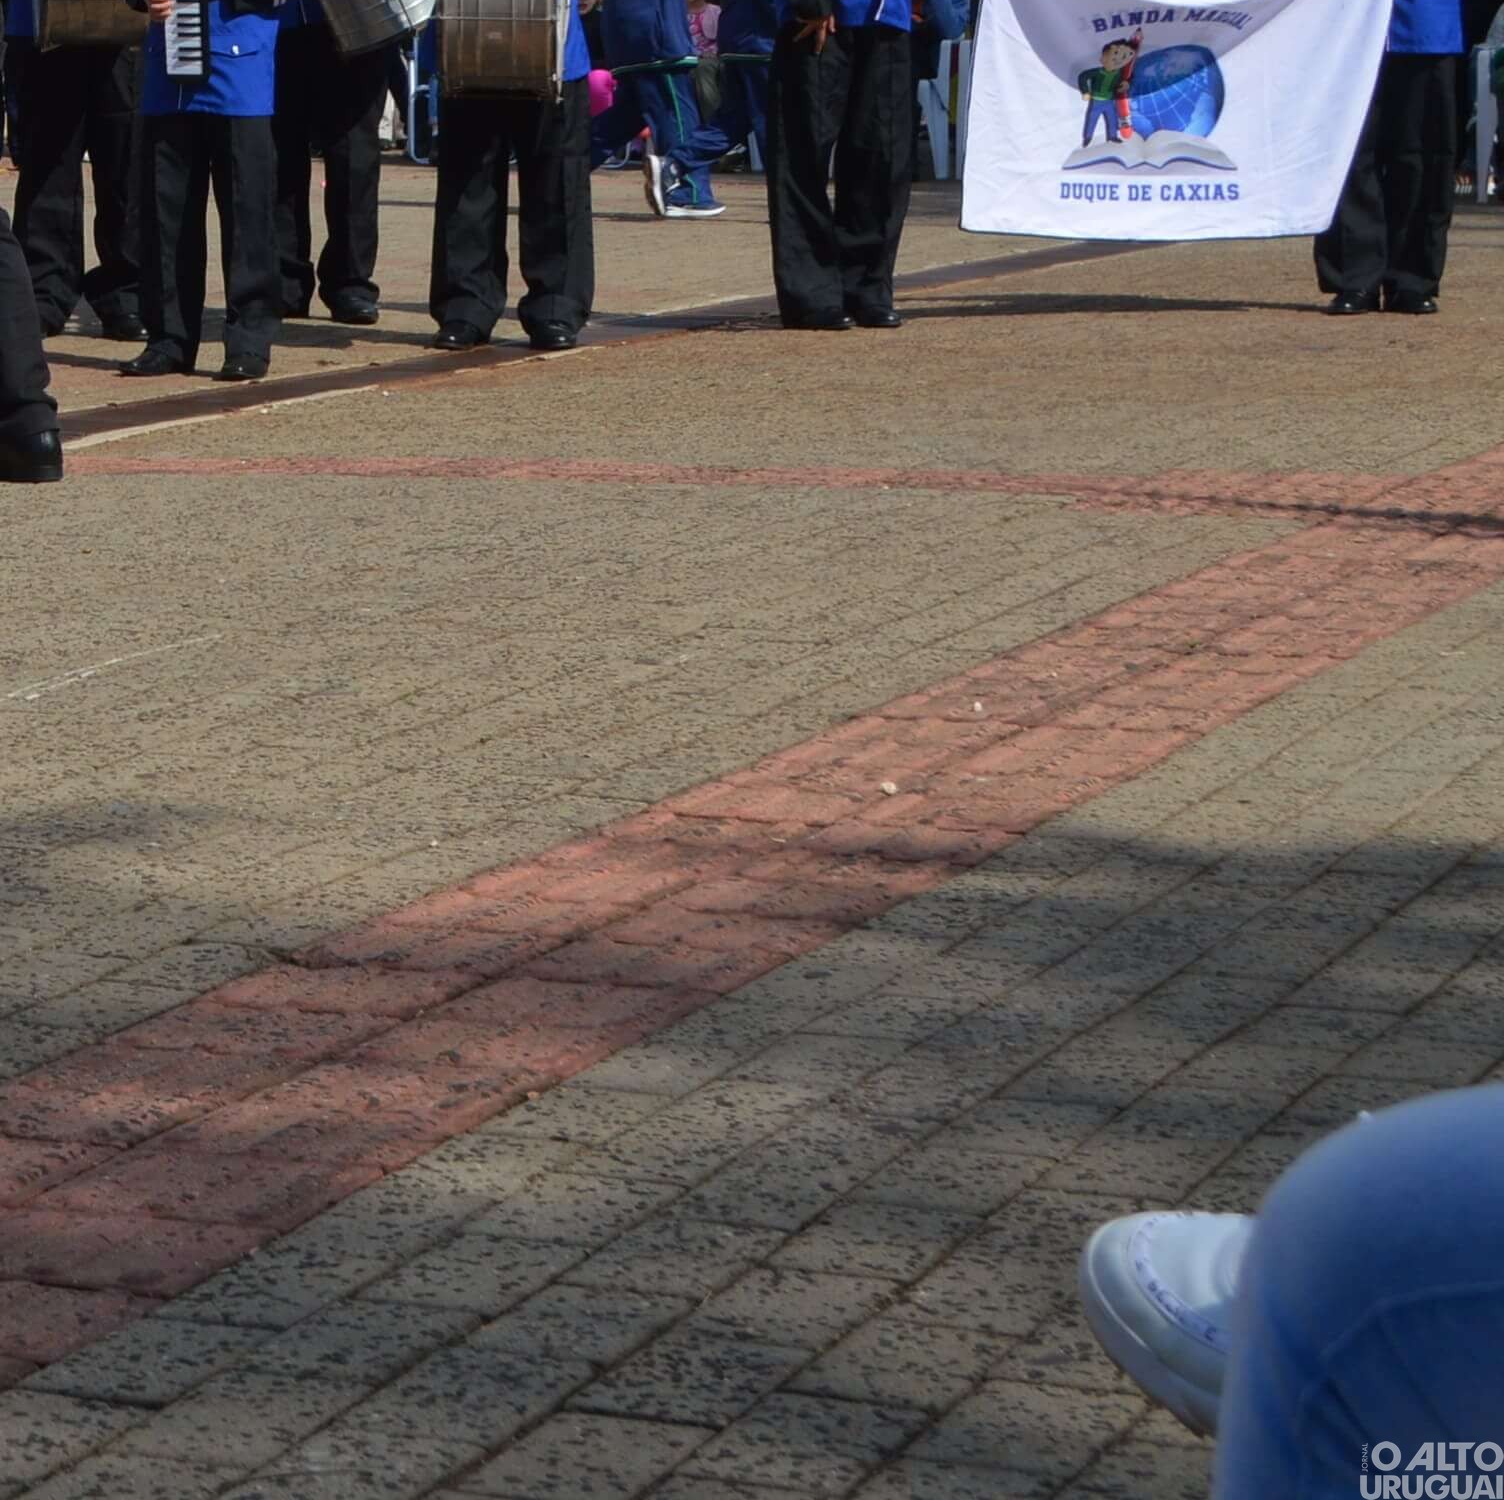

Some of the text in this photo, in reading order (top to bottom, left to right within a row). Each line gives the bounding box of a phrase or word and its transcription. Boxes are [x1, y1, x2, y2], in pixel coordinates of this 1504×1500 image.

[1092, 8, 1176, 33] BANDA
[1060, 182, 1241, 202] DUQUE DE CAXIAS
